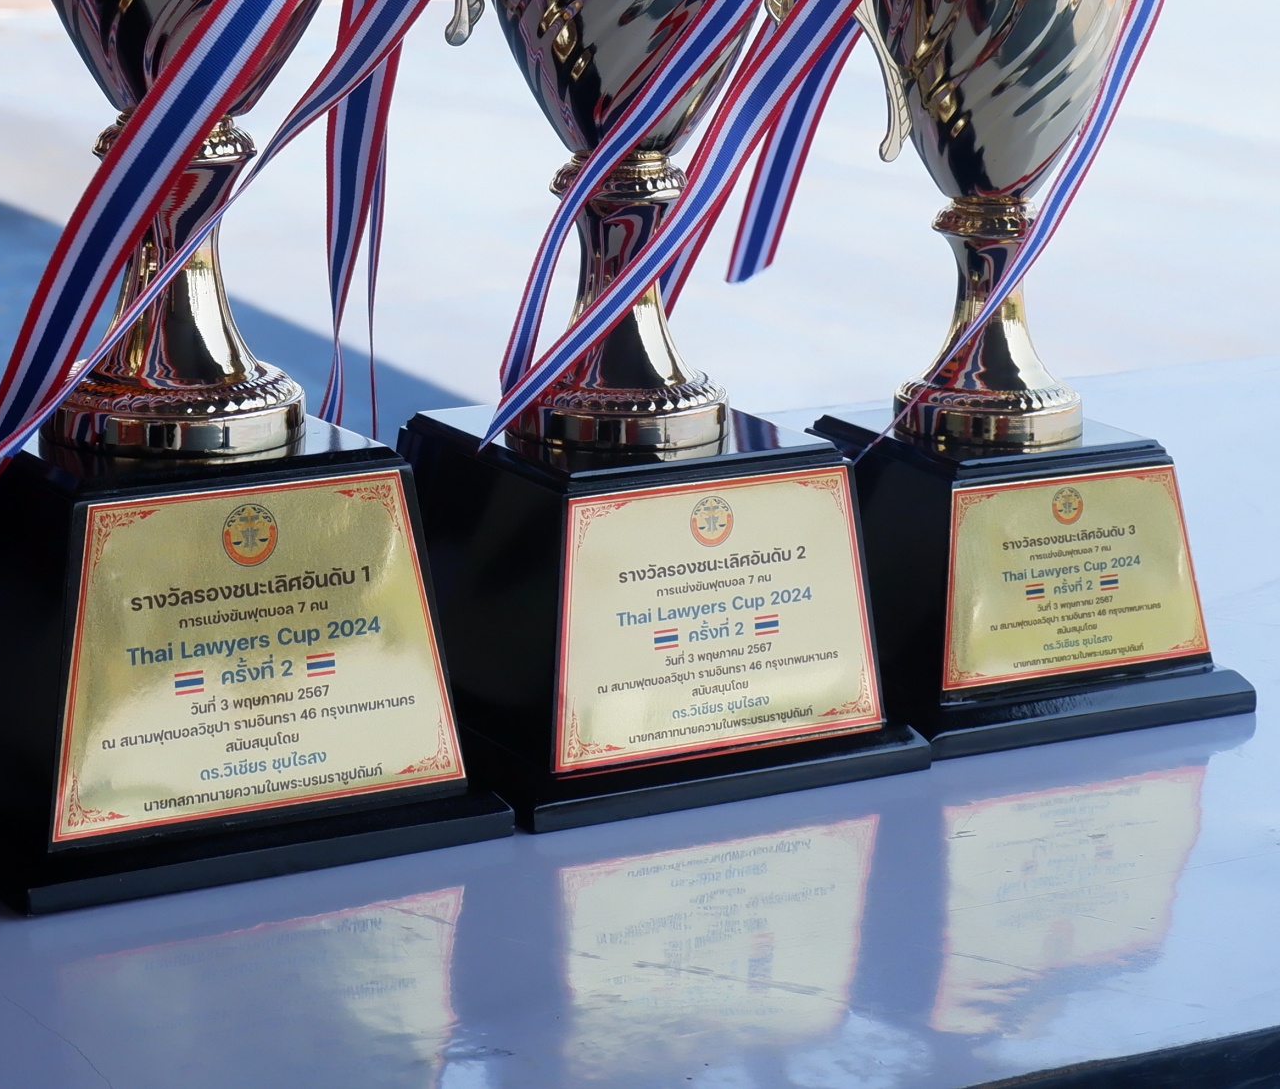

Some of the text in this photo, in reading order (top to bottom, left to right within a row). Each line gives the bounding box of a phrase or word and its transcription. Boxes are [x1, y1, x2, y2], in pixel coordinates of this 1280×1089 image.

[1128, 524, 1135, 535] 3
[618, 545, 806, 583] รางวัลรองชนะเลิศอันดับ 2
[1001, 554, 1141, 582] Thai Lawyers Cup 2024
[130, 565, 370, 611] รางวัลรองชนะเลิศอันดับ 1
[656, 574, 771, 597] การแข่งขันฟุตบอล 7 คน
[1085, 579, 1093, 590] 2
[178, 600, 328, 629] การแข่งขันฟุตบอล 7 คน
[616, 586, 812, 627] Thai Lawyers Cup 2024
[1053, 602, 1058, 610] 3
[1095, 595, 1113, 604] 2567
[1097, 608, 1107, 616] 46
[126, 615, 381, 666] Thai Lawyers Cup 2024
[688, 617, 744, 642] ครั้งที่ 2
[665, 641, 772, 666] วันที่ 3 พฤษภาคม 2567
[221, 653, 293, 685] ครั้งที่ 2
[597, 685, 608, 694] ณ
[698, 664, 746, 679] รามอินทรา
[749, 660, 762, 670] 46
[765, 650, 838, 670] กรุงเทพมหานคร
[190, 684, 329, 715] วันที่ 3 พฤษภาคม 2567
[691, 679, 748, 696] สนับสนุนโดย
[101, 695, 415, 750] ณ สนามฟุตบอลวิชุปา รามอินทรา 46 กรุงเทพมหานคร
[672, 701, 723, 719] ดร.วิเชียร
[225, 731, 299, 752] สนับสนุนโดย
[200, 758, 267, 780] ดร.วิเชียร
[144, 762, 382, 811] นายกสภาทนายความในพระบรมราชูปถัมภ์
